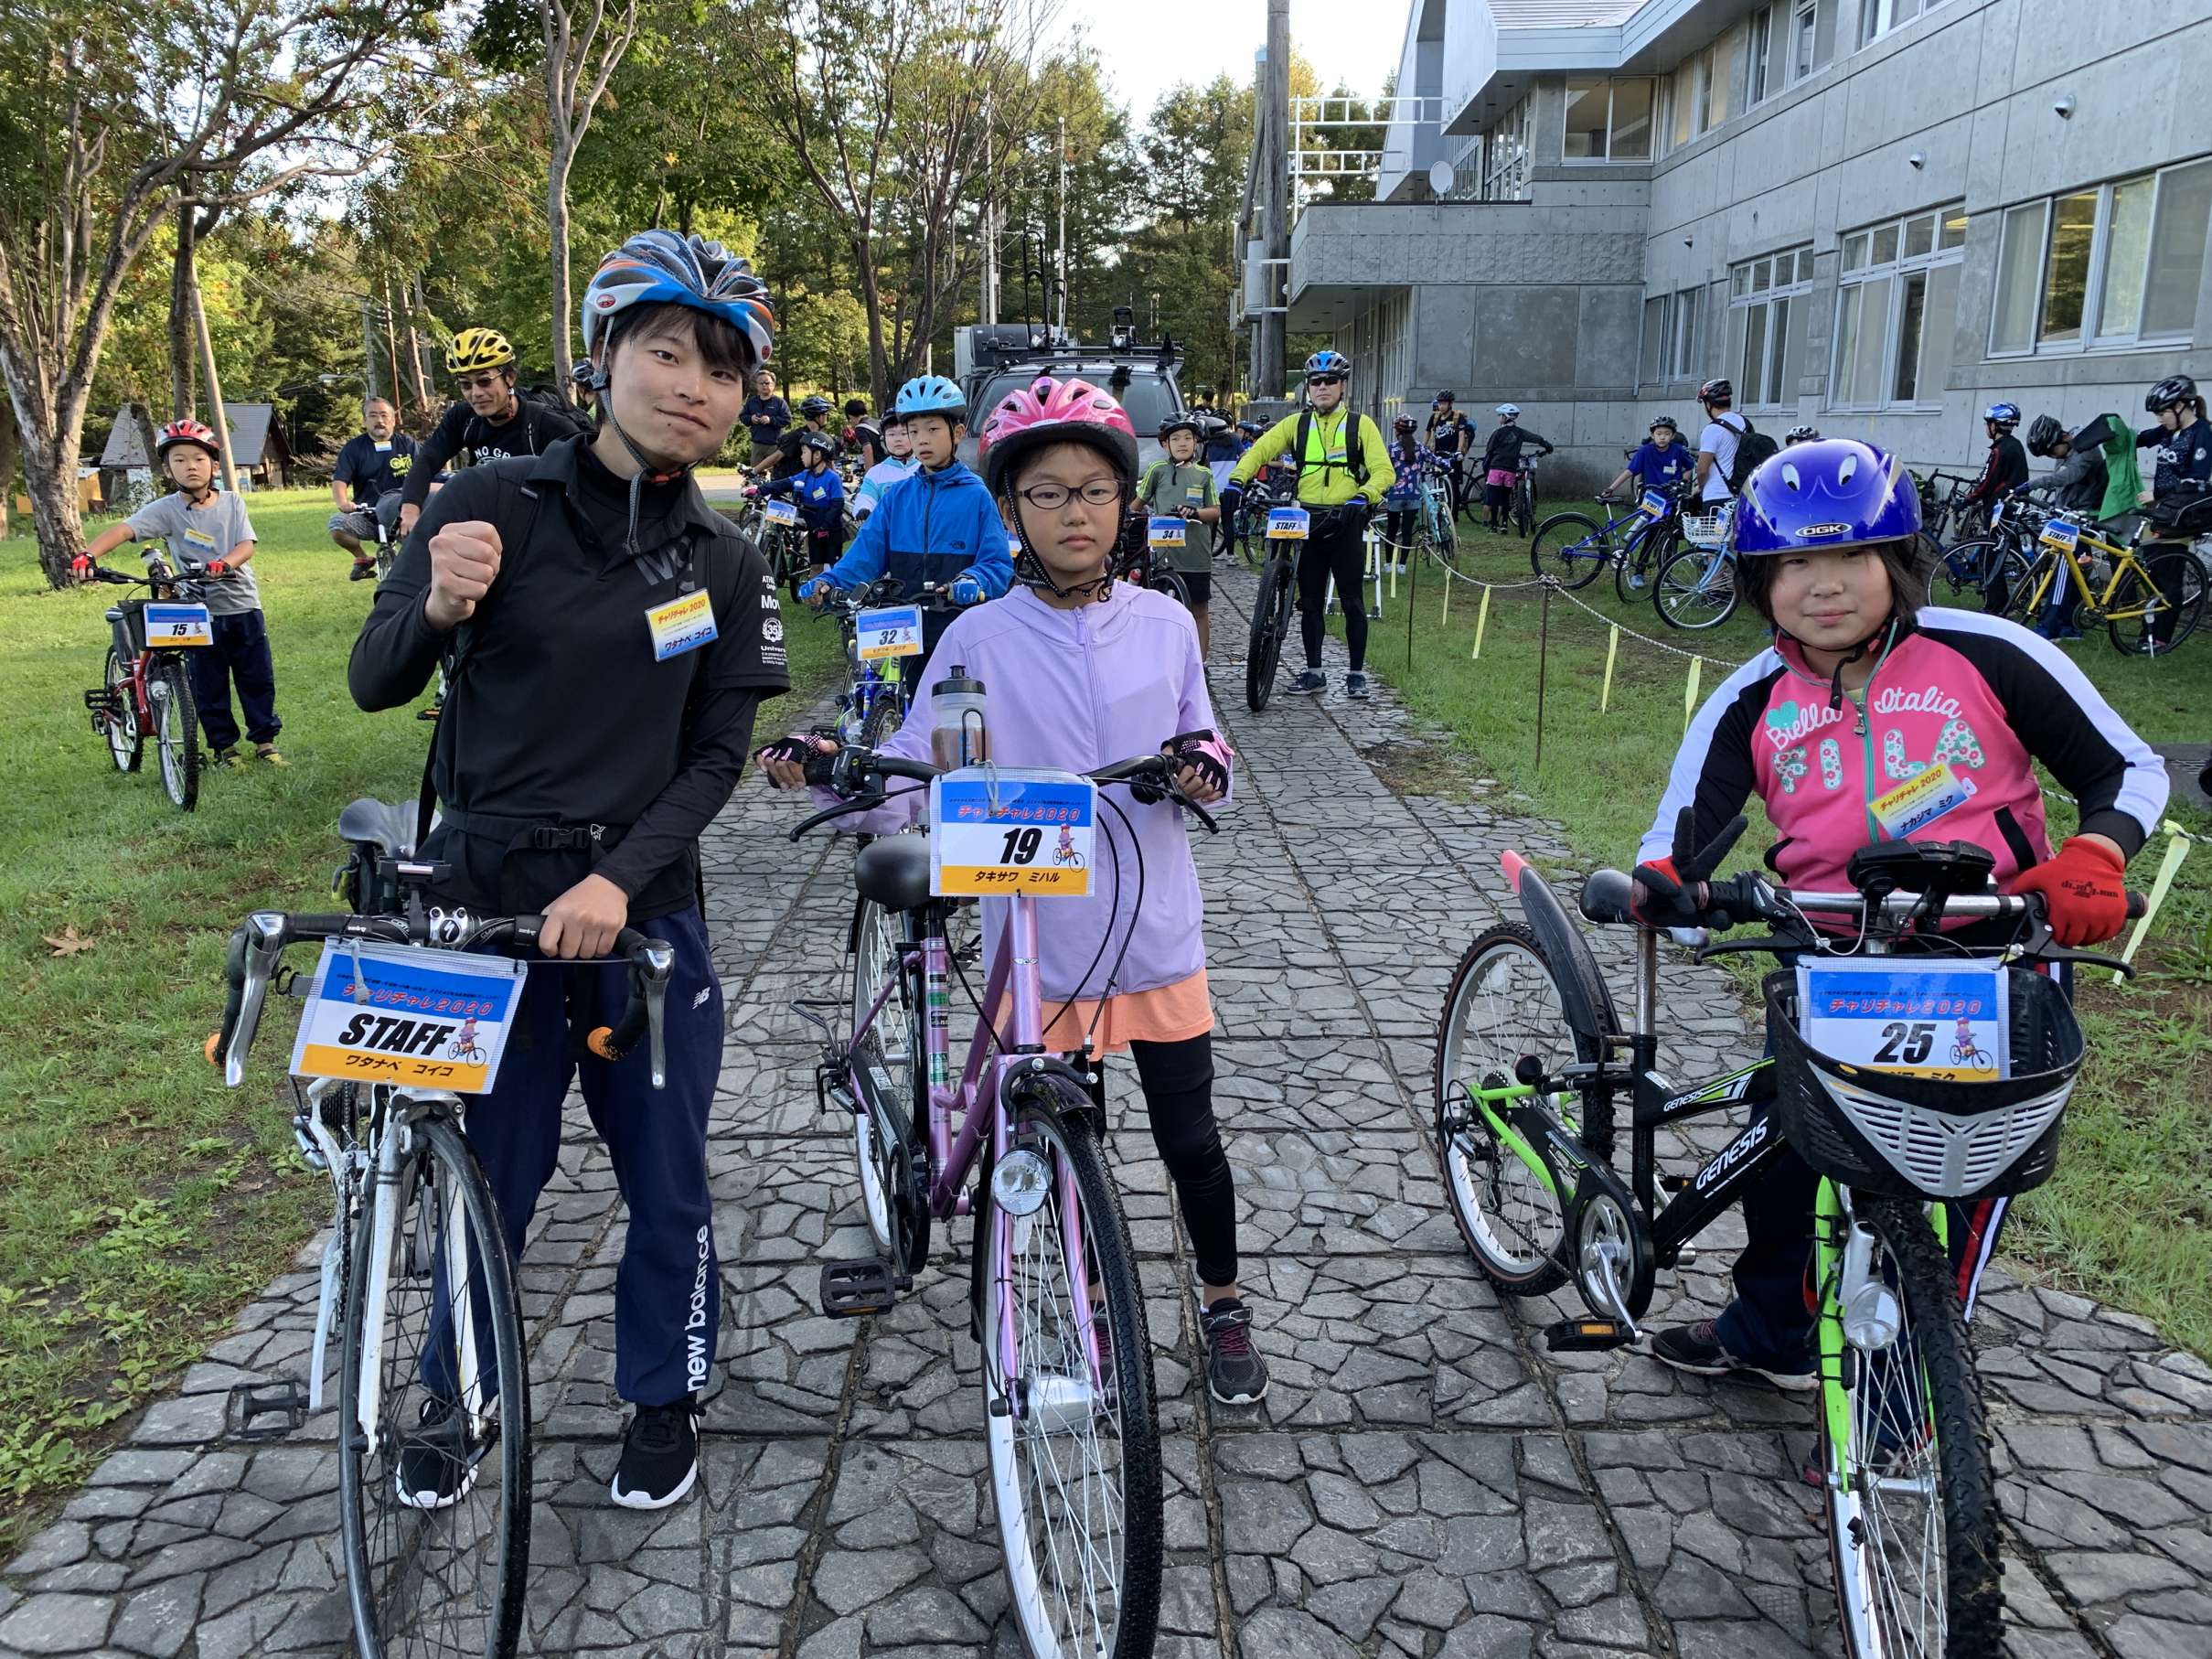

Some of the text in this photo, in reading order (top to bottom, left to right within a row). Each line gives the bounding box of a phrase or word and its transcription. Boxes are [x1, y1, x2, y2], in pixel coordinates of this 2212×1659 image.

[475, 446, 488, 459] NO
[1162, 530, 1174, 540] 34
[1275, 521, 1297, 530] STAFF
[1803, 524, 1842, 536] OGK
[2048, 530, 2068, 541] STAFF
[657, 607, 688, 625] チャリチャレ
[689, 599, 706, 613] 2020
[172, 624, 187, 636] 15
[879, 629, 897, 645] 32
[1766, 686, 1962, 750] Biella Italia
[1771, 719, 1986, 795] FILA
[1880, 785, 1919, 811] チャリチャレ
[1920, 769, 1942, 787] 2020
[958, 805, 1081, 821] チャチャレ2020
[1900, 808, 1932, 831] ナカジマ
[1939, 795, 1954, 808] ミク
[999, 828, 1042, 865] 19
[975, 871, 1060, 883] タキサワ ミハル
[341, 983, 494, 1016] チリチャレ2020
[338, 1013, 456, 1055] STAFF
[1873, 1022, 1937, 1064] 25
[1663, 1088, 1704, 1112] GENESIS
[1695, 1117, 1769, 1191] GENESIS
[685, 1225, 710, 1392] new balance
